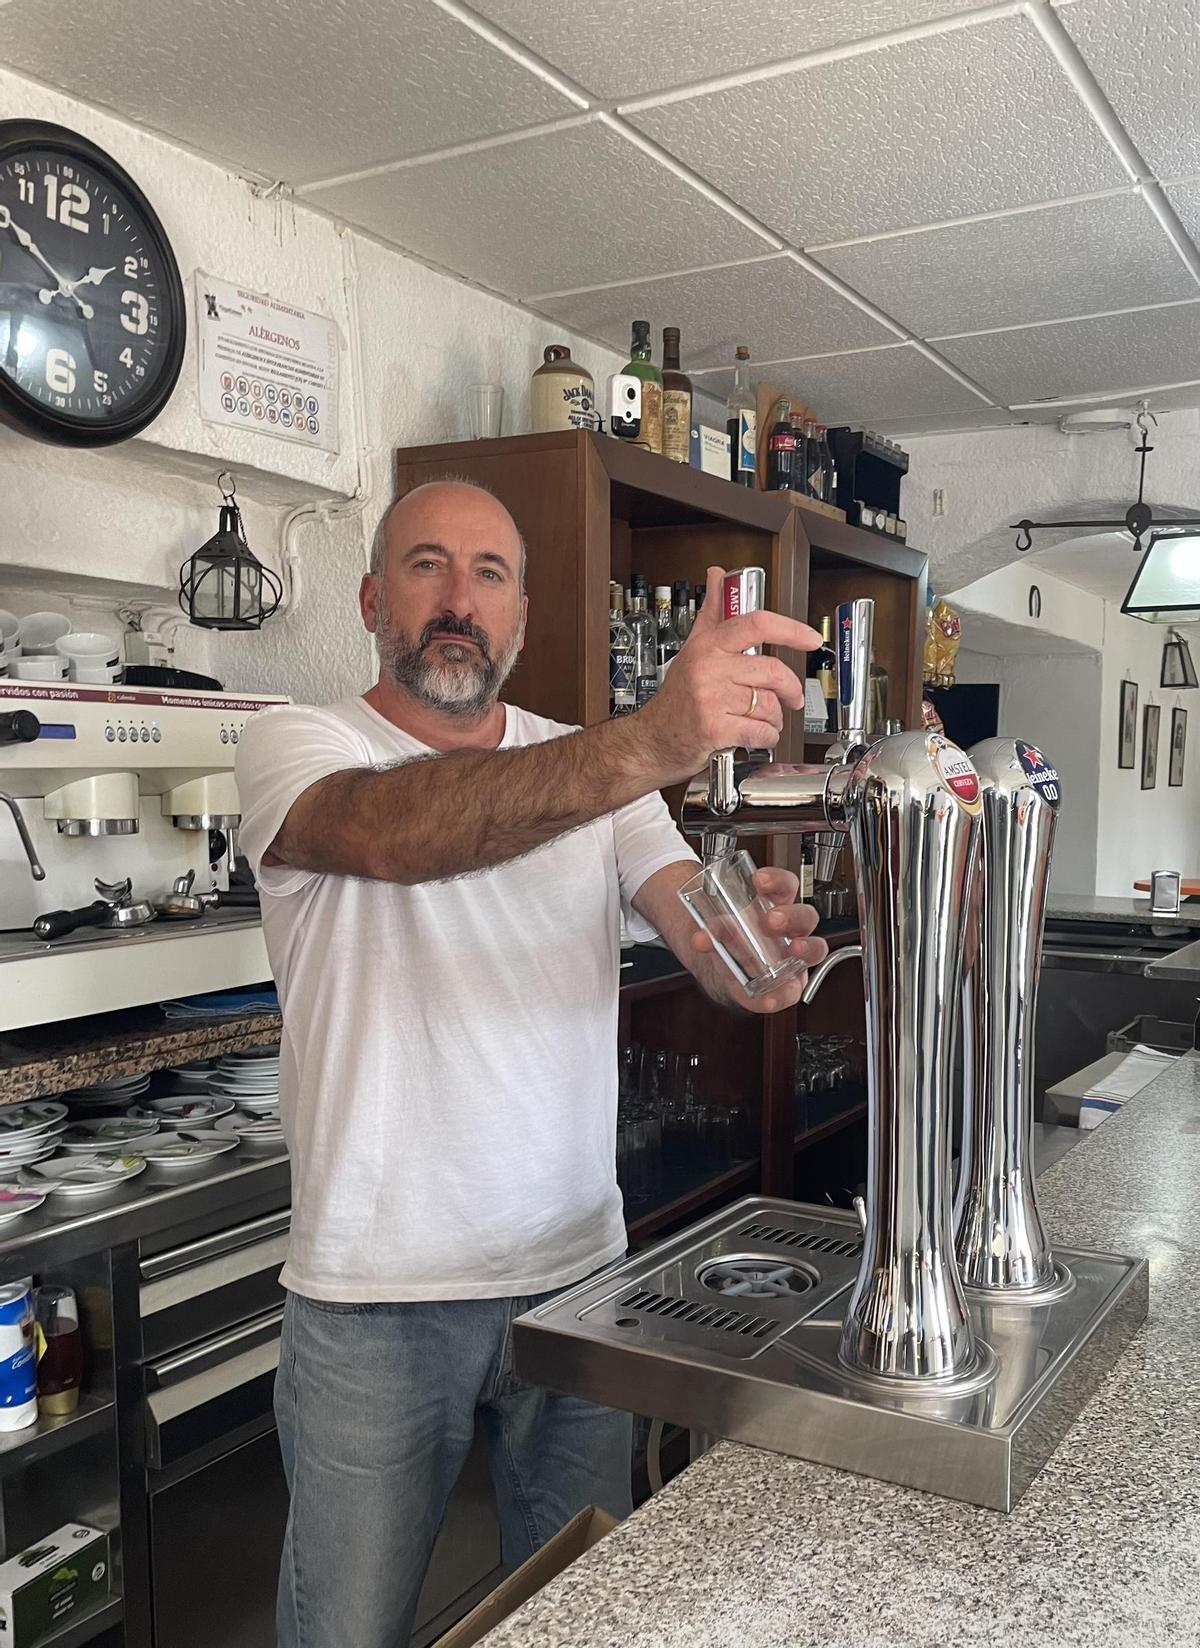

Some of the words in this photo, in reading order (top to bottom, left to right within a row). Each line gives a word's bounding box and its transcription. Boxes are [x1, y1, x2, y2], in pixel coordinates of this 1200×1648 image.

[18, 178, 35, 204] 11
[44, 173, 91, 234] 12
[102, 213, 109, 235] 1
[124, 256, 138, 279] 2
[140, 257, 149, 269] 10
[120, 290, 149, 335] 3
[149, 314, 158, 326] 15
[248, 325, 301, 352] ALÉRGENOS
[119, 347, 133, 368] 4
[45, 348, 76, 394] 6
[135, 365, 145, 378] 20
[93, 370, 108, 393] 5
[55, 396, 66, 408] 30
[102, 394, 112, 406] 25
[563, 387, 581, 401] JACK
[730, 586, 740, 616] AMST
[0, 687, 31, 697] rvidos
[32, 689, 49, 697] con
[50, 688, 79, 699] pasión
[161, 696, 201, 706] Momentos
[225, 700, 255, 709] servidos
[943, 761, 972, 775] AMSTEL
[1026, 767, 1059, 784] eineke
